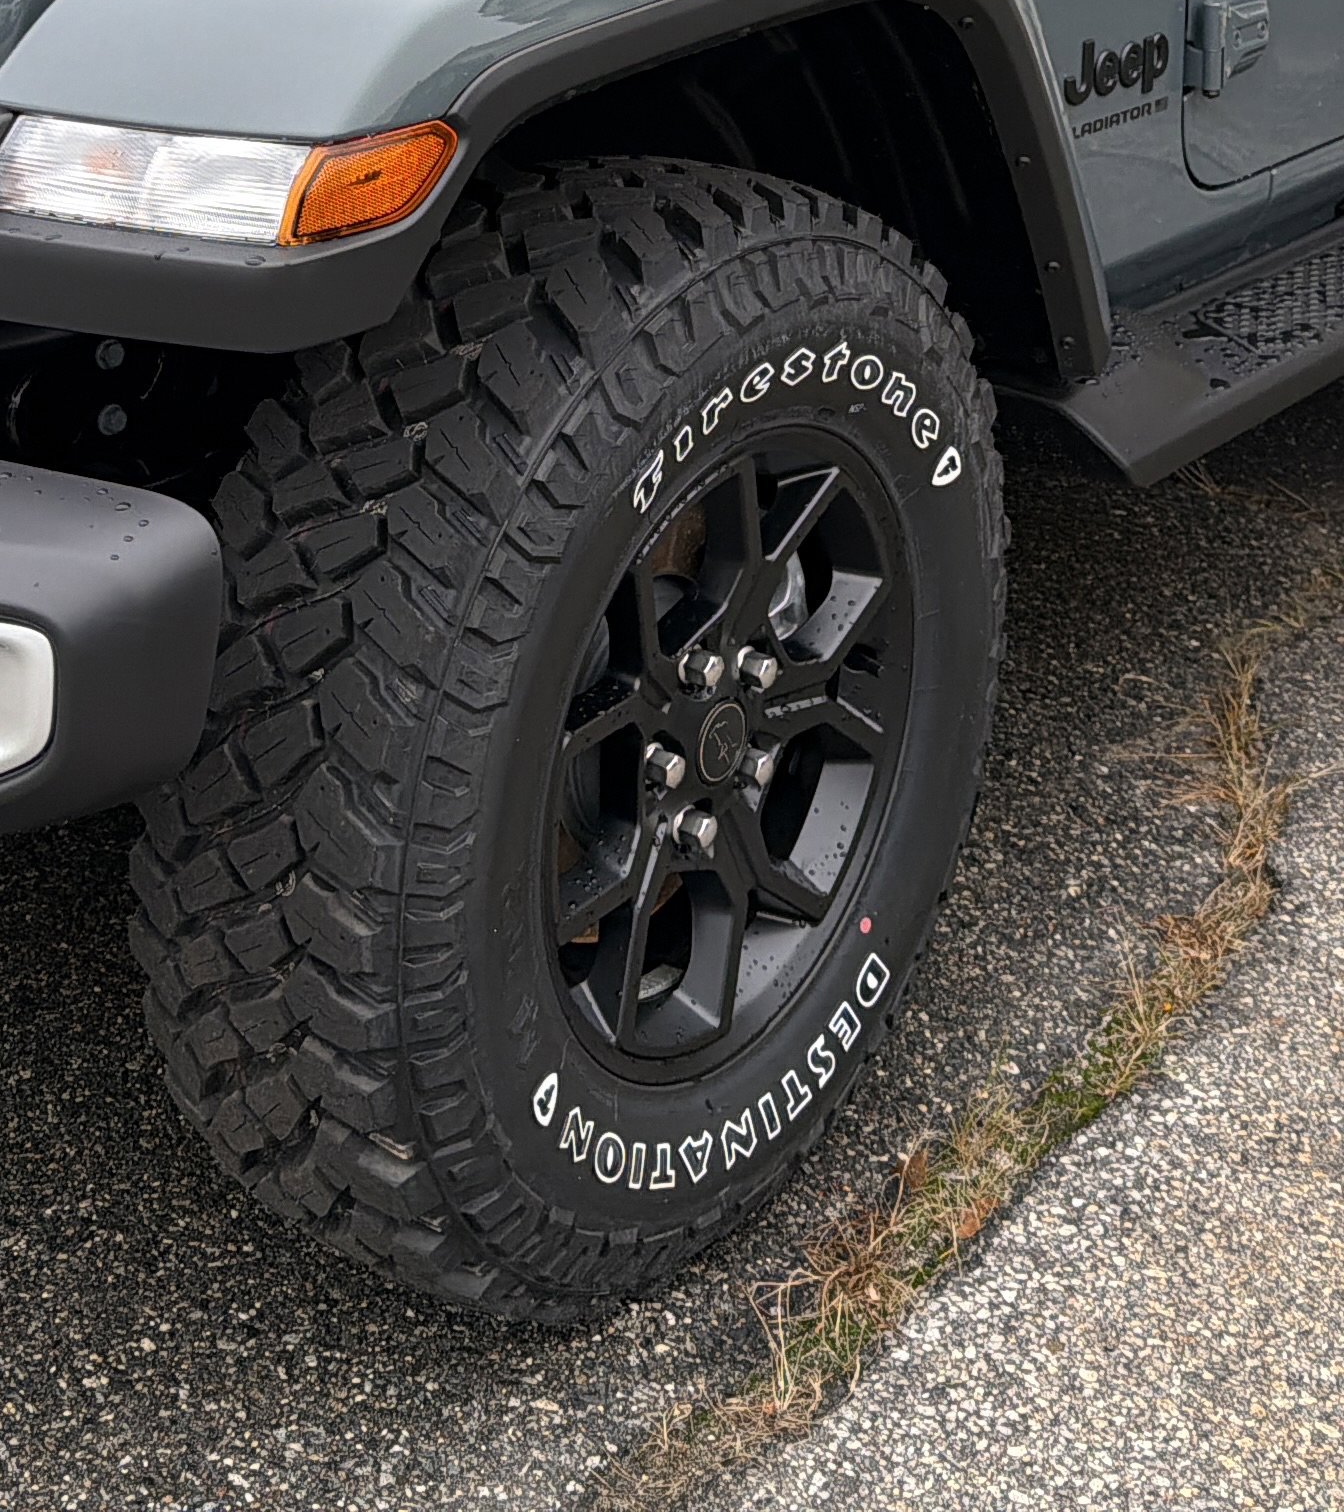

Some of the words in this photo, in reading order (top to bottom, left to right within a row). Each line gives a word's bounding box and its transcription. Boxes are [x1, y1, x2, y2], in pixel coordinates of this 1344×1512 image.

[1063, 31, 1170, 107] Jeep
[1071, 102, 1153, 140] LADIATOR
[633, 341, 941, 515] Firestone
[560, 952, 891, 1190] DESTINATION
